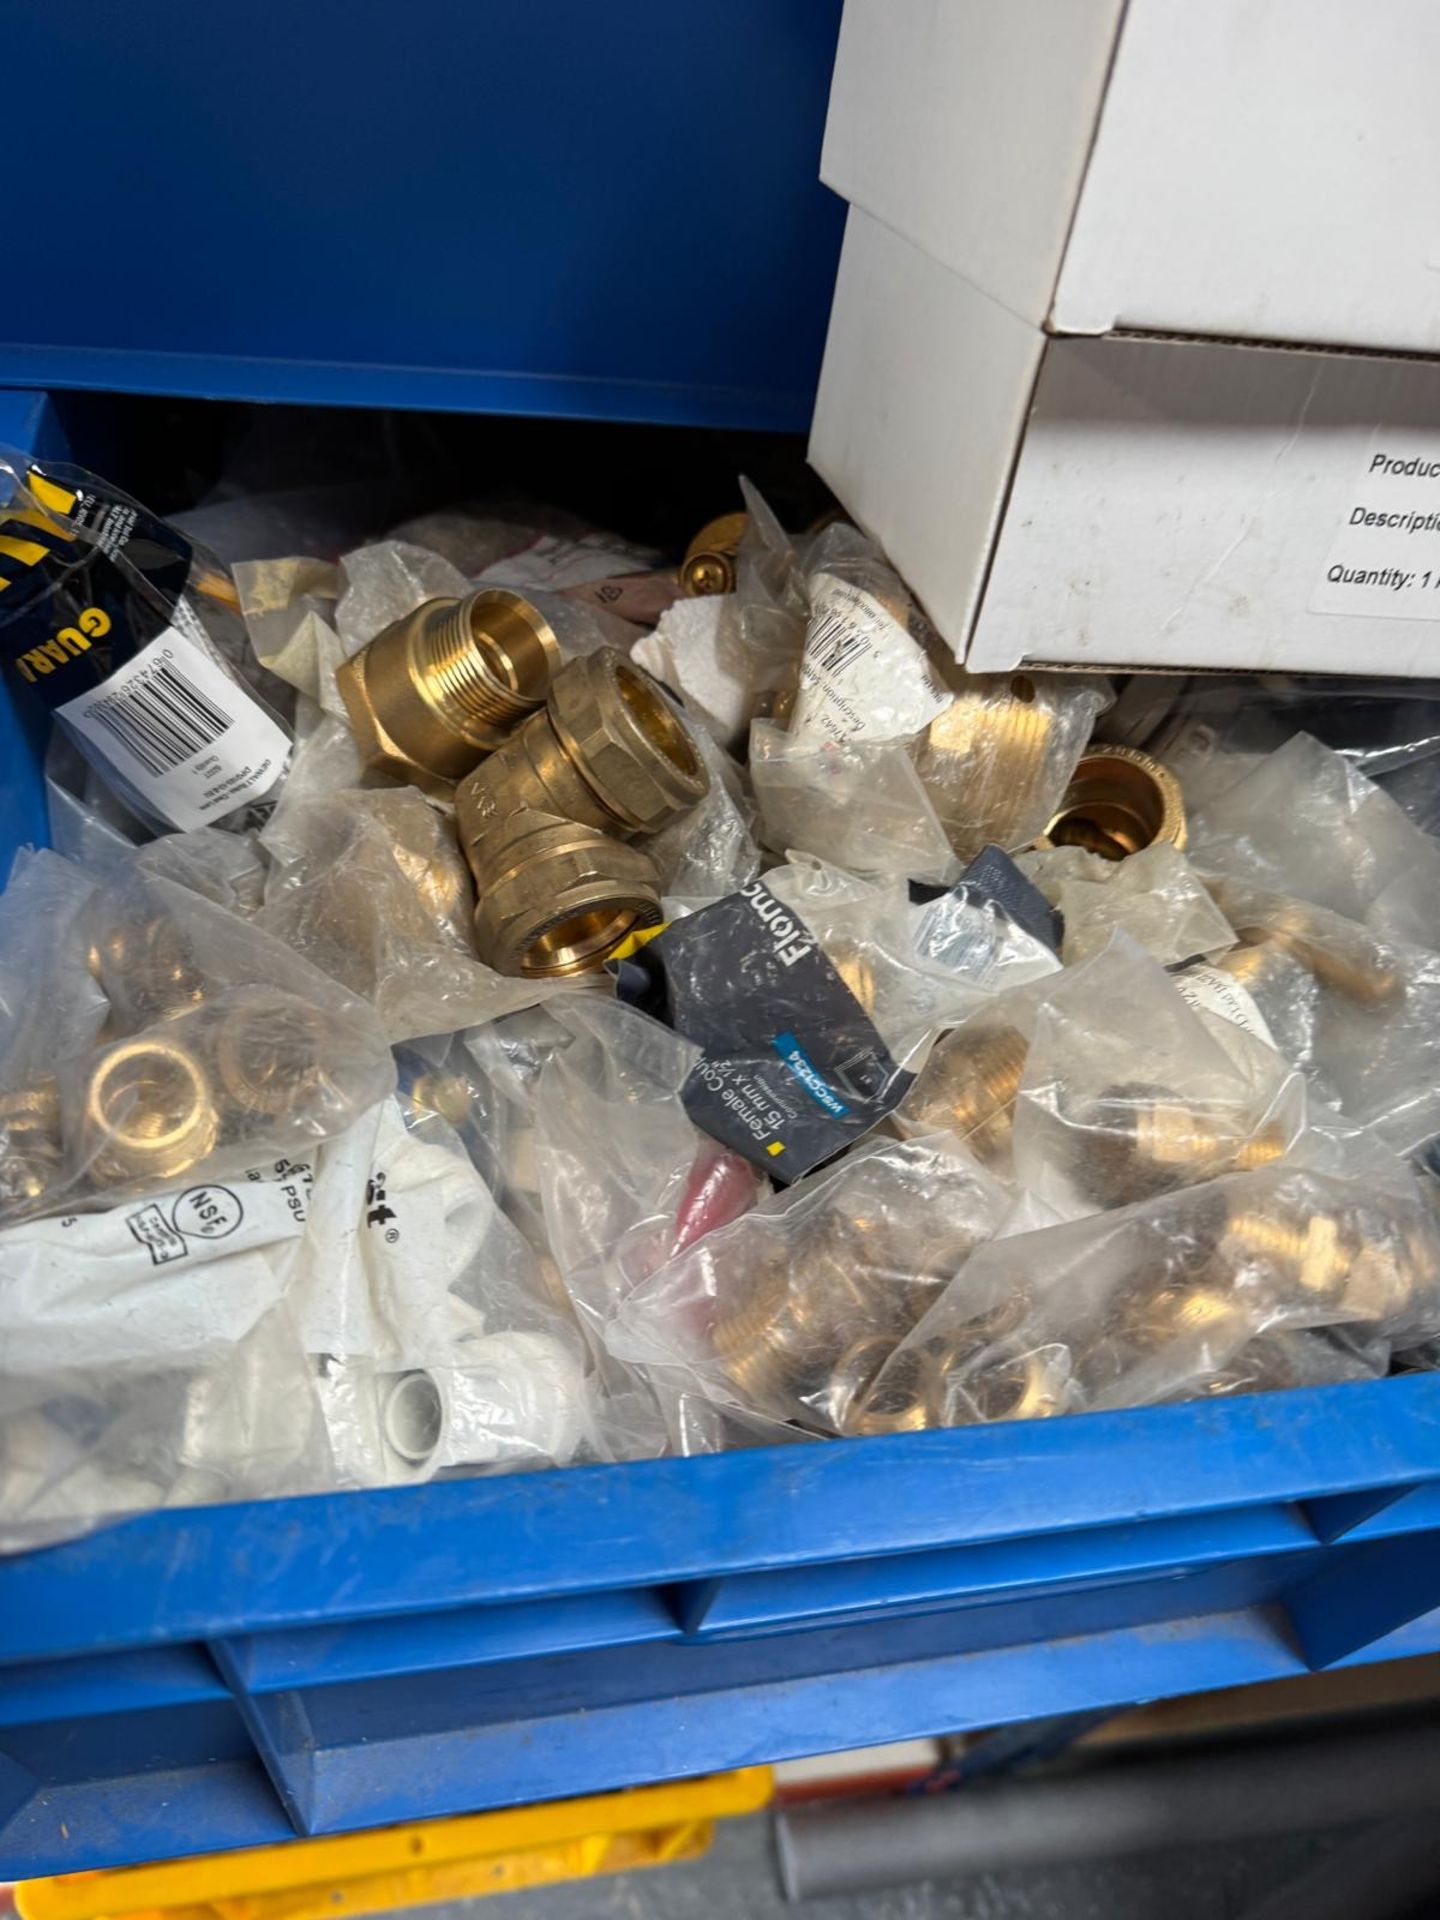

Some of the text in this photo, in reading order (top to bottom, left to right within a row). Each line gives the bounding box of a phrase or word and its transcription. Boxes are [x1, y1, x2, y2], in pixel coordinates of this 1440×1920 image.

[1369, 454, 1440, 478] Produc
[1327, 564, 1415, 591] Quantity:
[1421, 570, 1432, 589] 1
[788, 1050, 844, 1113] WSCC1234
[741, 1084, 771, 1112] mm
[753, 1074, 798, 1119] Compression
[721, 1088, 771, 1140] Female
[767, 1111, 785, 1131] 15
